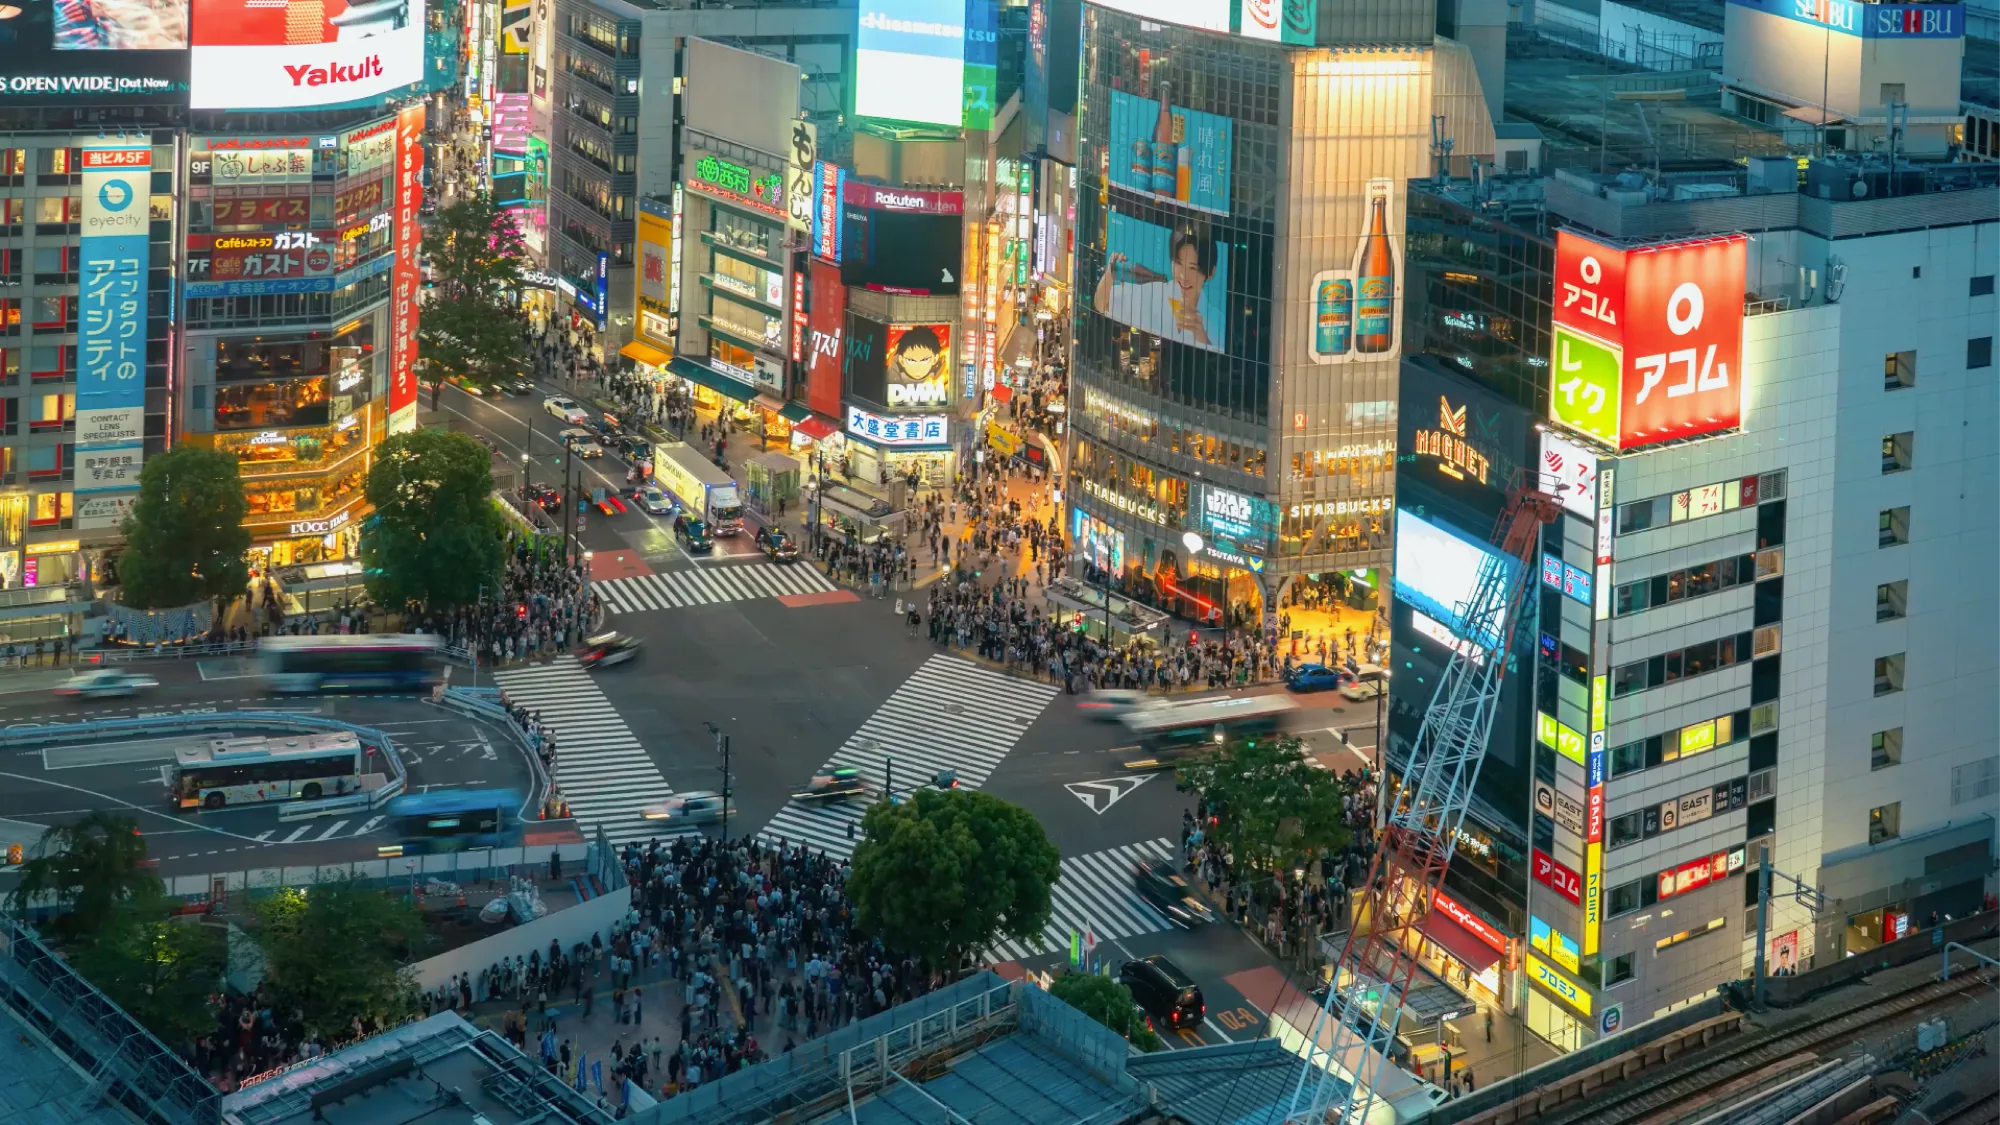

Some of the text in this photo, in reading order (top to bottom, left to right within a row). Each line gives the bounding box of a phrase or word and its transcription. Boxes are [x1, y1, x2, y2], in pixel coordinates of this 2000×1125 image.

[1878, 9, 1952, 34] SEIBU
[283, 54, 383, 87] Yakult
[10, 76, 58, 91] OPEN
[143, 77, 169, 88] Now
[89, 151, 145, 165] 当ビル5F
[191, 161, 211, 173] 9F
[247, 155, 306, 175] しゃぶ葉
[719, 169, 749, 194] 西村
[875, 191, 925, 209] Rakuten
[89, 214, 142, 229] eyecity
[369, 212, 392, 233] ガスト
[846, 211, 868, 222] SHIBUYA
[274, 232, 320, 250] ガスト
[188, 258, 210, 272] 7F
[243, 254, 299, 277] ガスト
[228, 281, 312, 294] 英会話イーオン
[1563, 281, 1617, 326] アコム
[86, 259, 116, 381] アイシティ
[117, 258, 139, 380] コンタクトの
[1634, 343, 1729, 406] アコム
[887, 382, 947, 403] DMM
[1558, 376, 1606, 414] イク
[90, 413, 130, 423] CONTACT
[99, 422, 120, 431] LENS
[853, 412, 941, 439] 大盛堂書店
[83, 430, 136, 440] SPECIALISTS
[85, 455, 133, 469] 隐形眼镜
[1416, 429, 1490, 485] MAGNET
[92, 468, 126, 480] 专卖店
[1213, 487, 1249, 507] STAR
[1702, 486, 1718, 499] アイ
[1743, 484, 1754, 498] 8F
[1085, 480, 1167, 525] STARBUCKS
[1290, 497, 1392, 519] STARBUCKS
[1702, 502, 1717, 514] フル
[1207, 547, 1245, 566] TSUTAYA
[1545, 719, 1581, 753] レイク
[1685, 727, 1709, 747] レイク
[1557, 797, 1582, 818] EAST
[1681, 794, 1710, 812] EAST
[1591, 806, 1600, 836] アコム
[1539, 858, 1580, 898] アコム
[1588, 872, 1598, 924] プロミス
[1539, 965, 1577, 1001] プロミス
